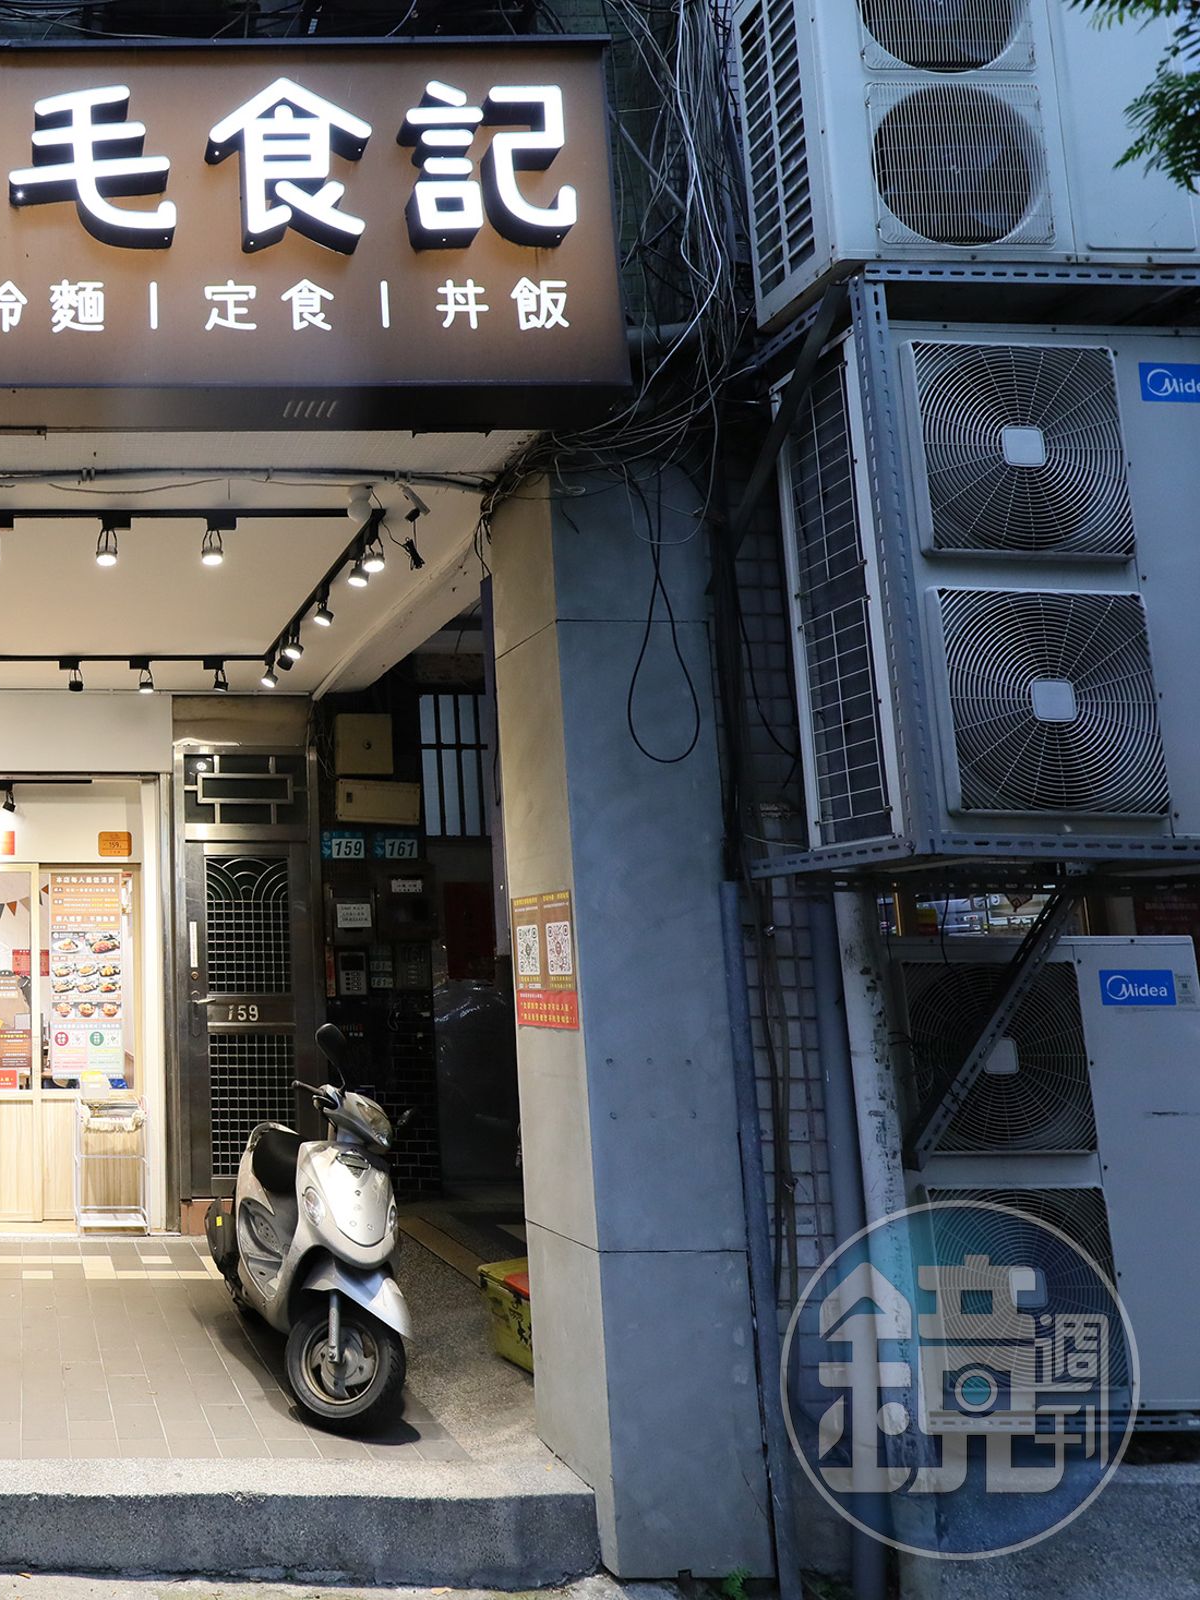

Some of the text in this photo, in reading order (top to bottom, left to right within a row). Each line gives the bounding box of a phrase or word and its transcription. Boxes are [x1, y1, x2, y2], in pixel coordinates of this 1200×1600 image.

[204, 279, 335, 331] 定食
[436, 277, 570, 331] 丼飯
[335, 841, 363, 856] 159
[388, 841, 416, 857] 161
[1108, 977, 1168, 999] Midea
[228, 1005, 258, 1021] 159
